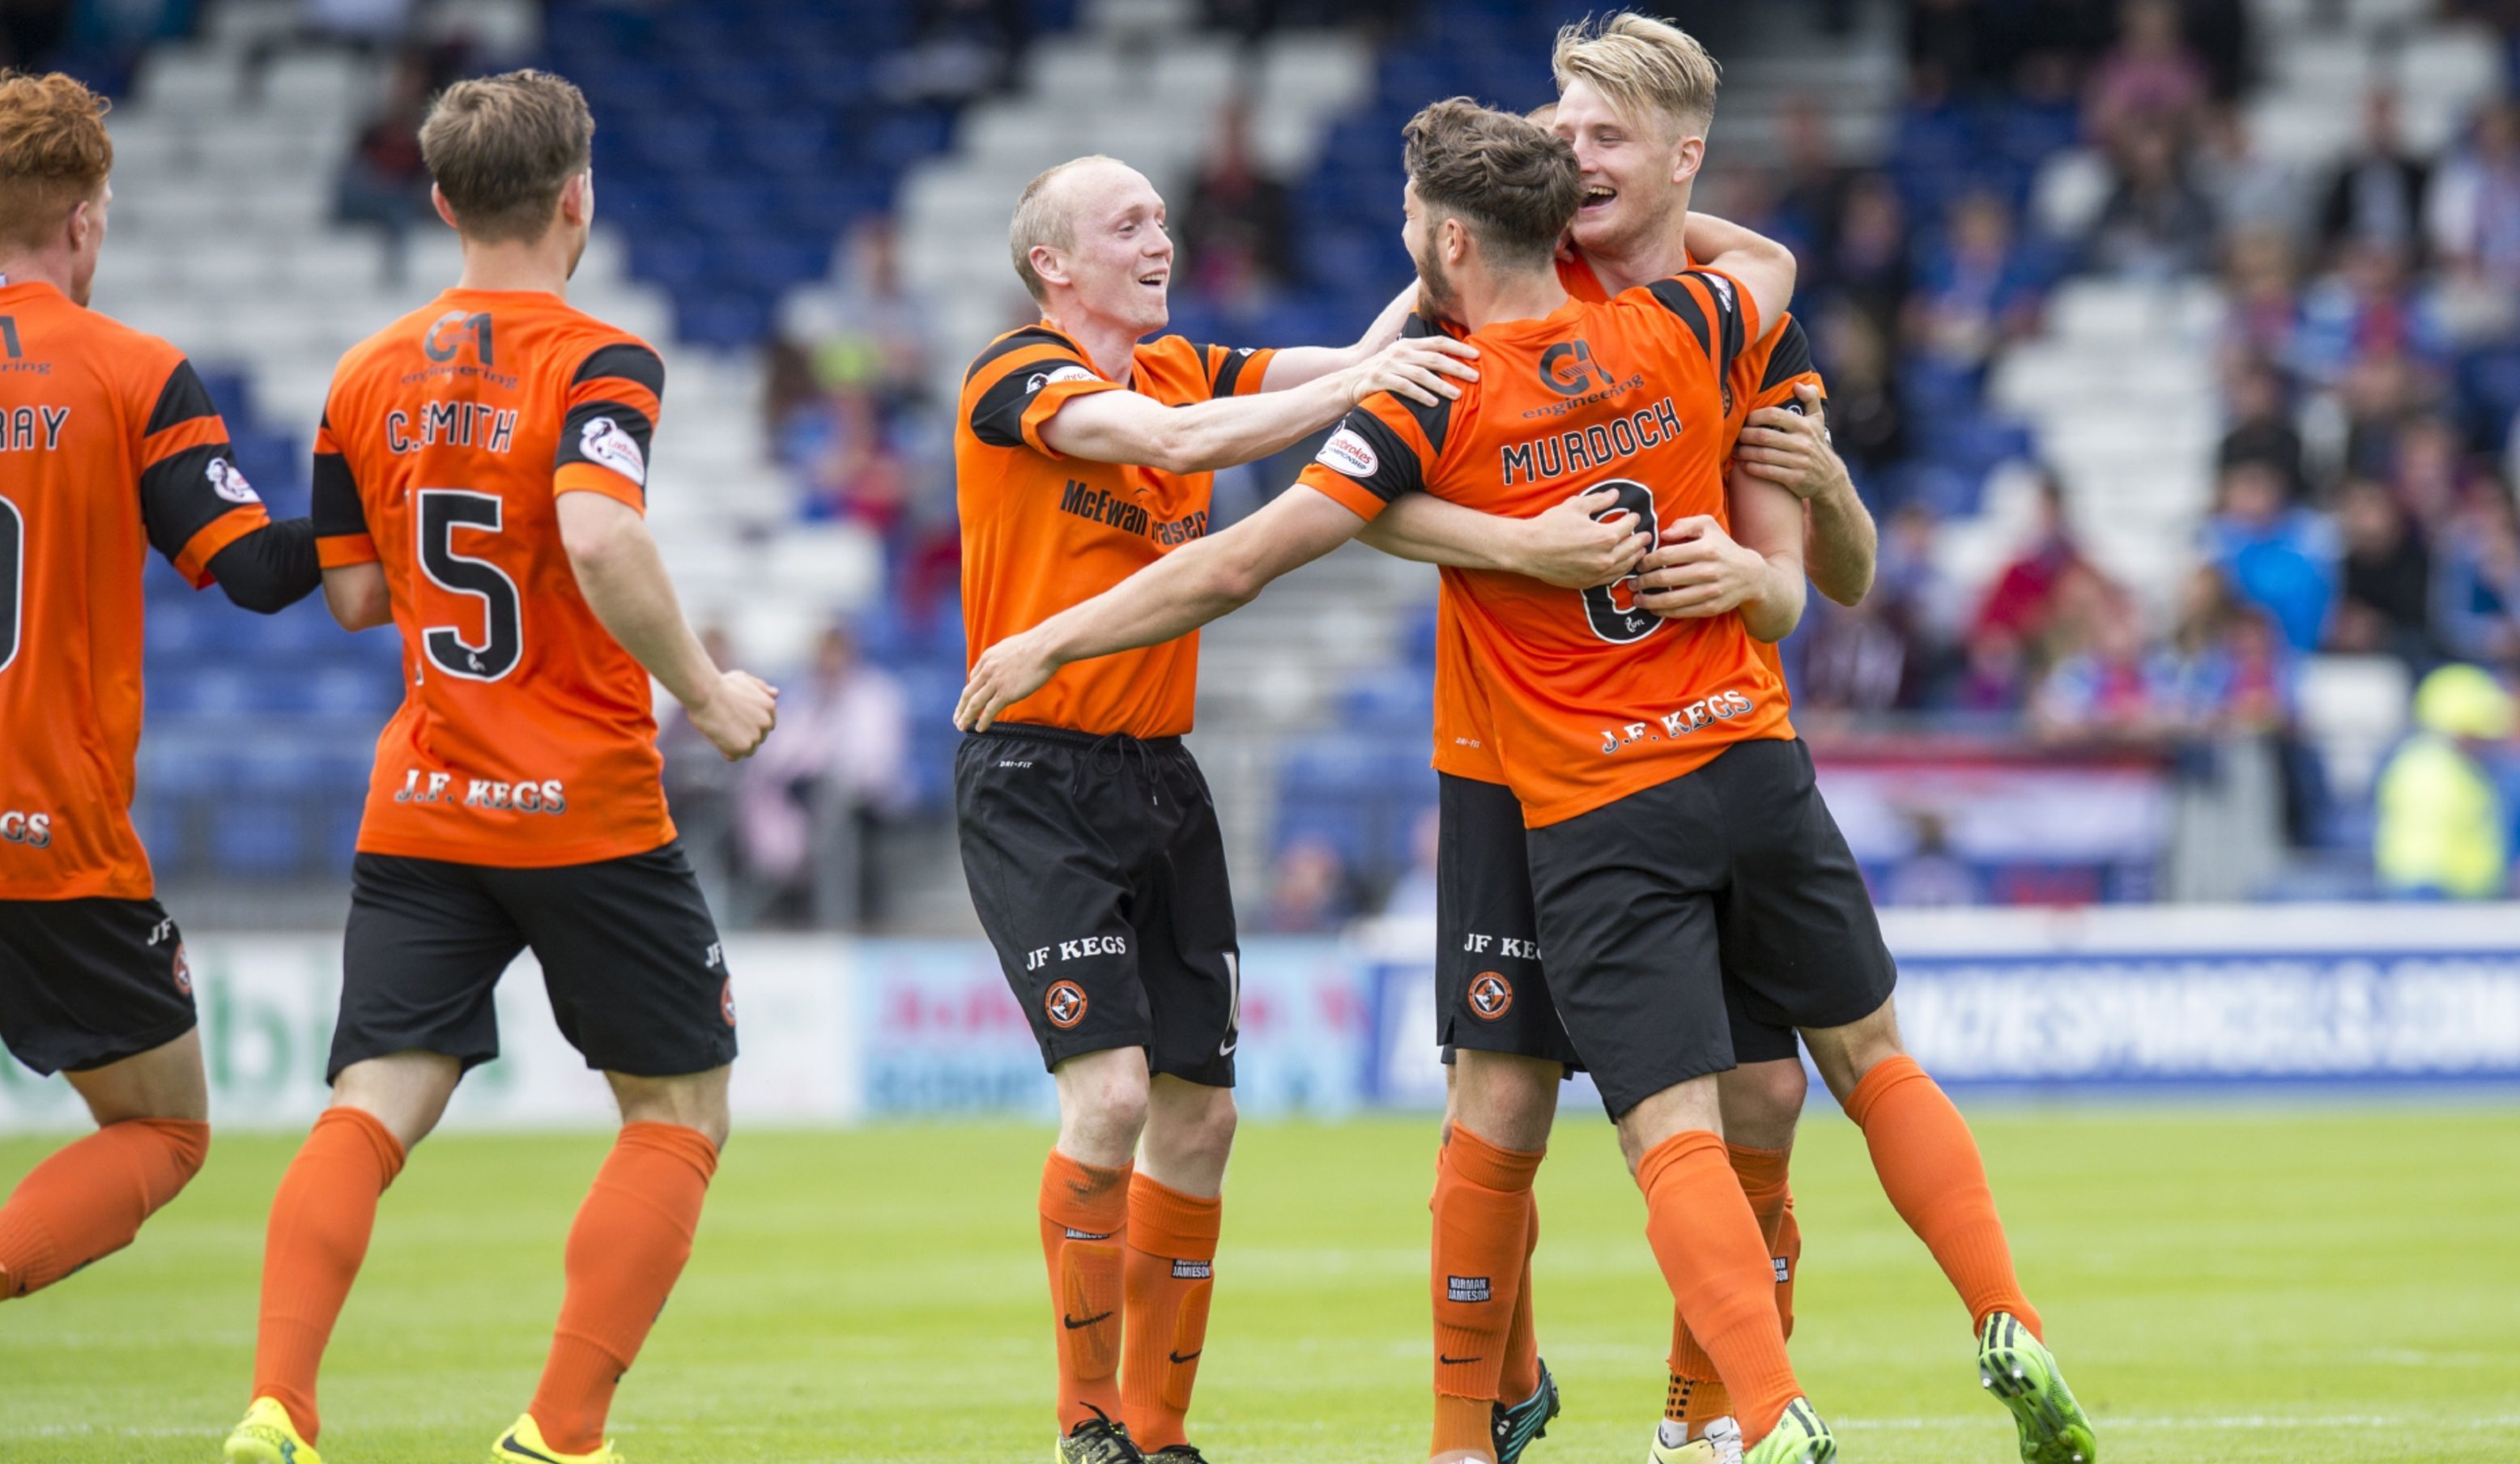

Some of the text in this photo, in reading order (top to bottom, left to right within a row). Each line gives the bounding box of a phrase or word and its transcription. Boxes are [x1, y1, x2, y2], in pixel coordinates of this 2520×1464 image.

[1522, 372, 1645, 420] engineering
[1501, 395, 1683, 486] MURDOCH
[1059, 479, 1149, 537] McEwan
[417, 488, 523, 683] 5
[1600, 690, 1754, 755] J.F. KEGS
[462, 779, 567, 815] KEGS
[1026, 936, 1126, 971] JF KEGS
[1463, 933, 1493, 953] JF
[1448, 1289, 1490, 1301] JAMIESON
[1449, 1277, 1487, 1289] NORMAN
